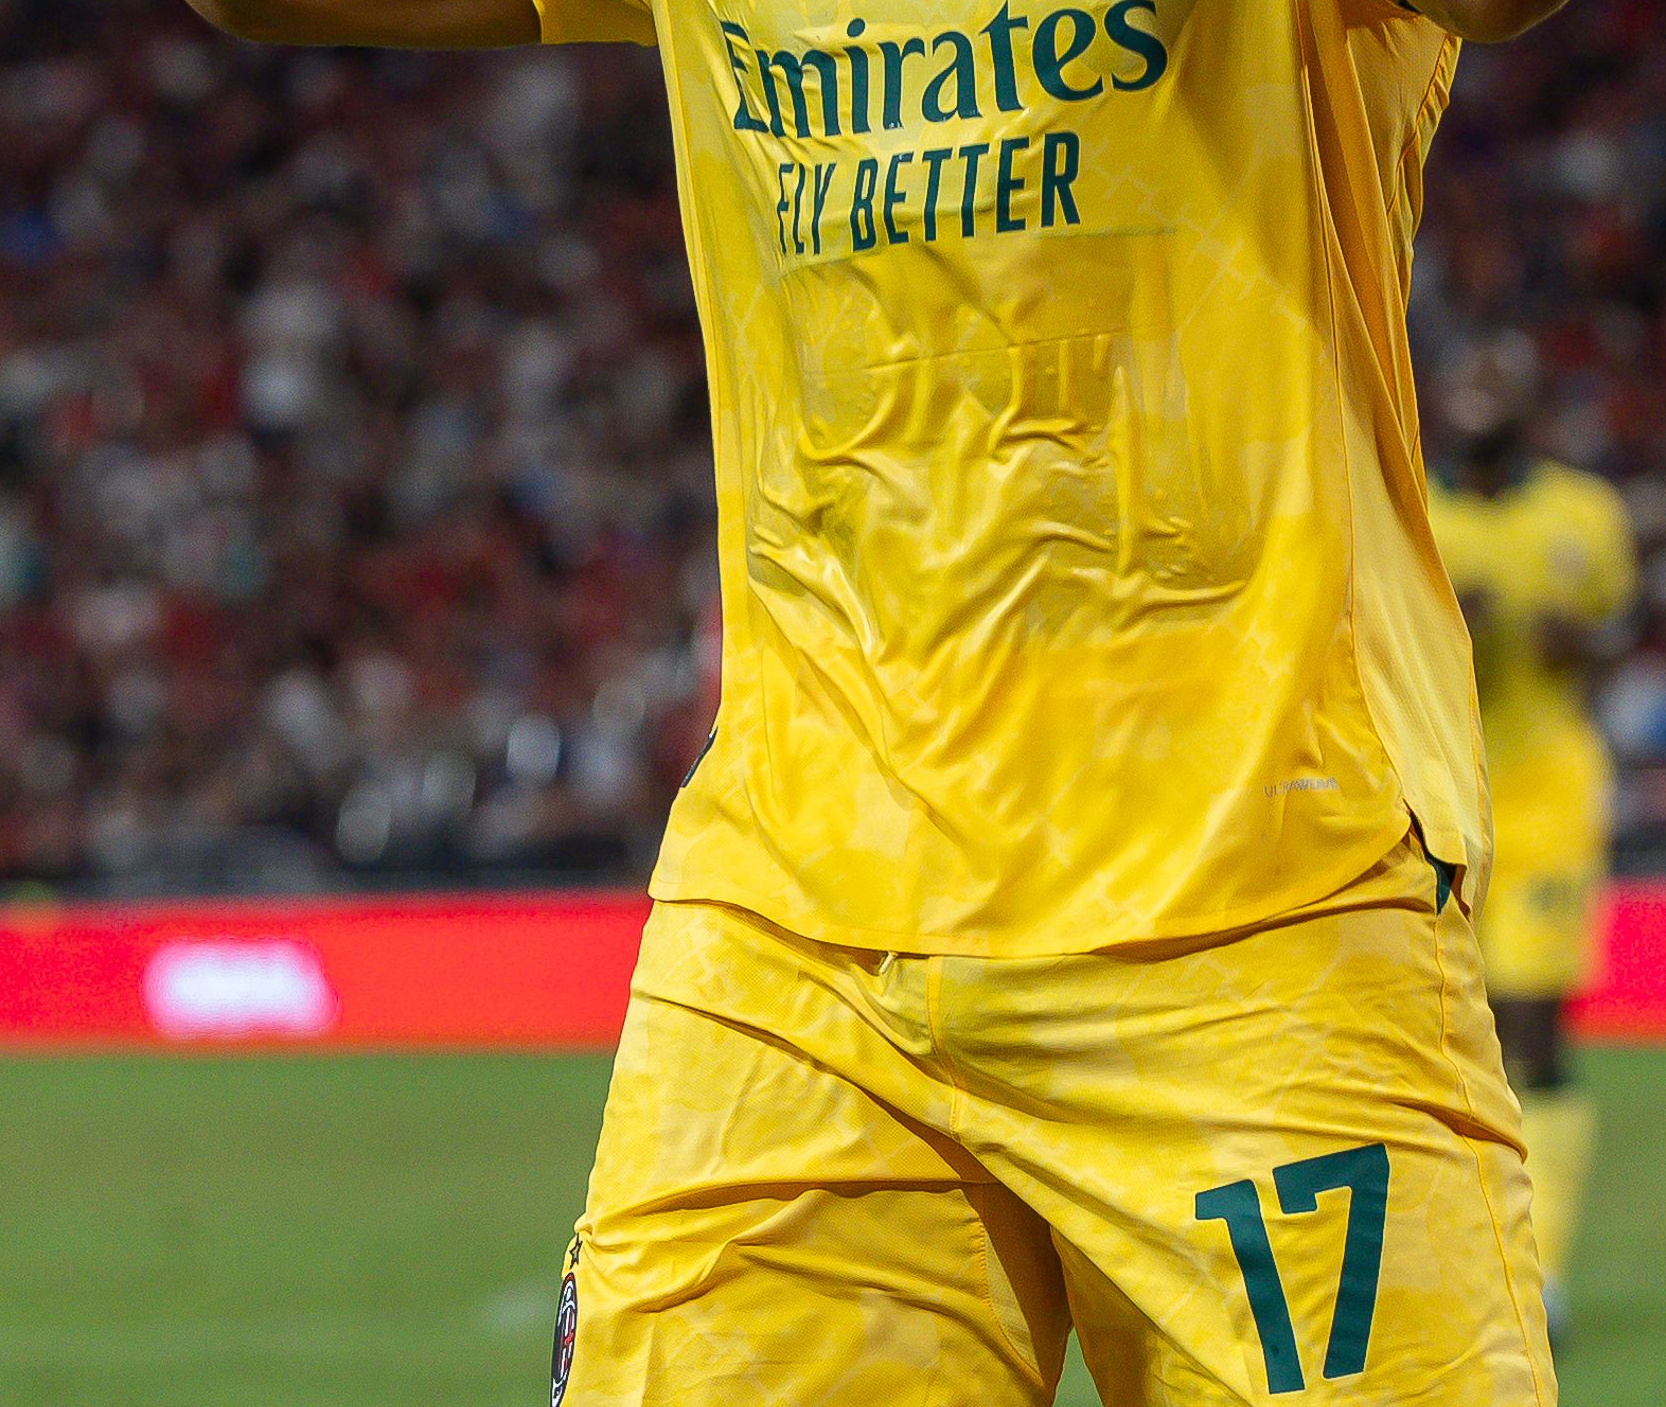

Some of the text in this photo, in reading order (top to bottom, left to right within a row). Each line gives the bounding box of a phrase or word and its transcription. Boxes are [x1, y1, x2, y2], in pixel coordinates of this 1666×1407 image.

[777, 131, 1082, 256] FLY BETTER
[1195, 1142, 1390, 1394] 17
